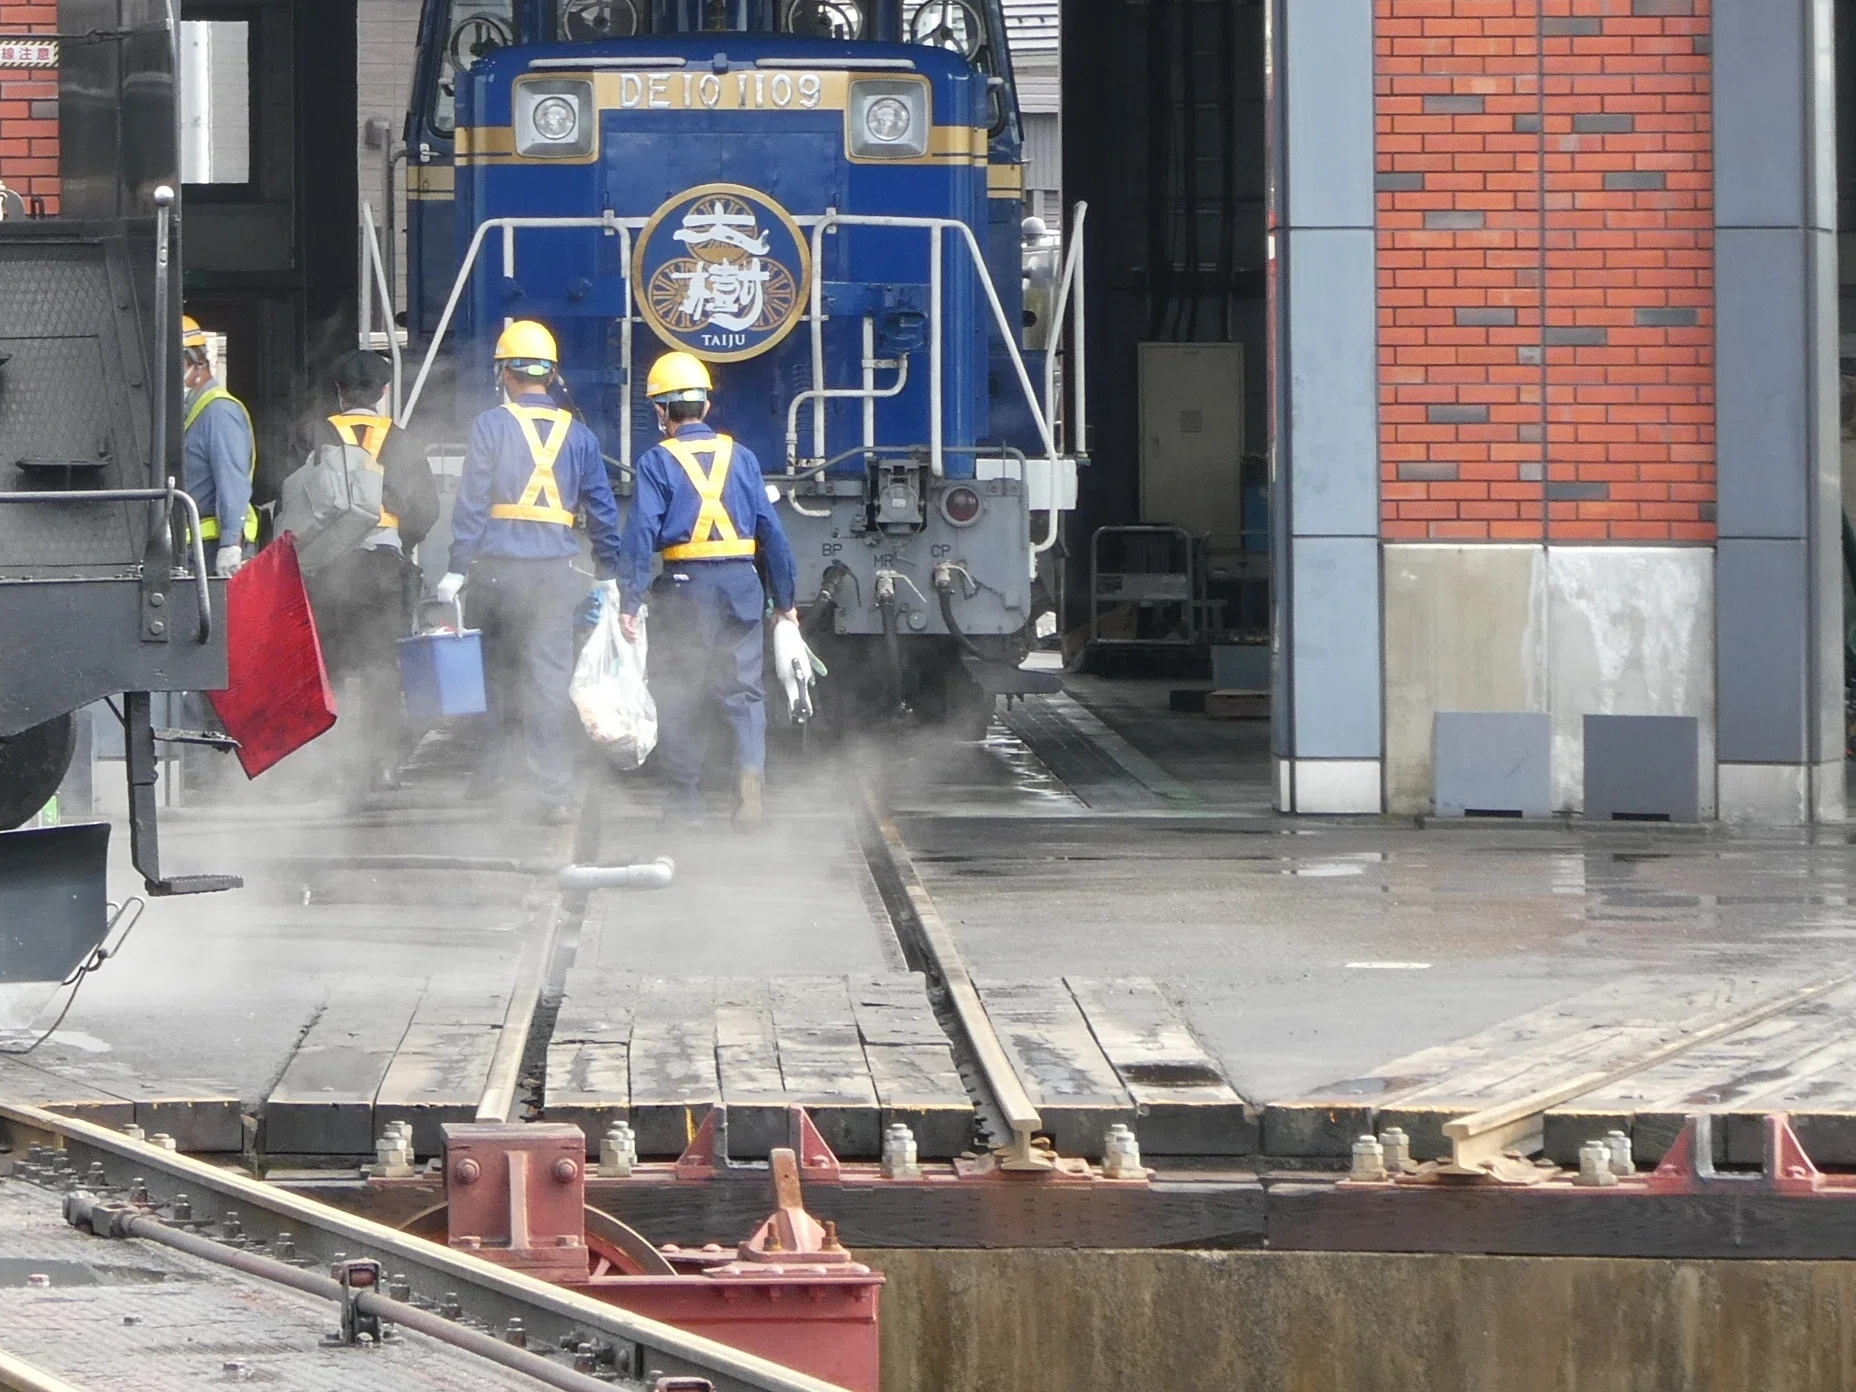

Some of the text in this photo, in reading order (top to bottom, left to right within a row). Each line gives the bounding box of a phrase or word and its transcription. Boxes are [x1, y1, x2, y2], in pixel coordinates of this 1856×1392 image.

[738, 73, 821, 108] 1109
[701, 334, 746, 348] TAIJU
[821, 543, 843, 557] BP
[931, 544, 951, 558] CP
